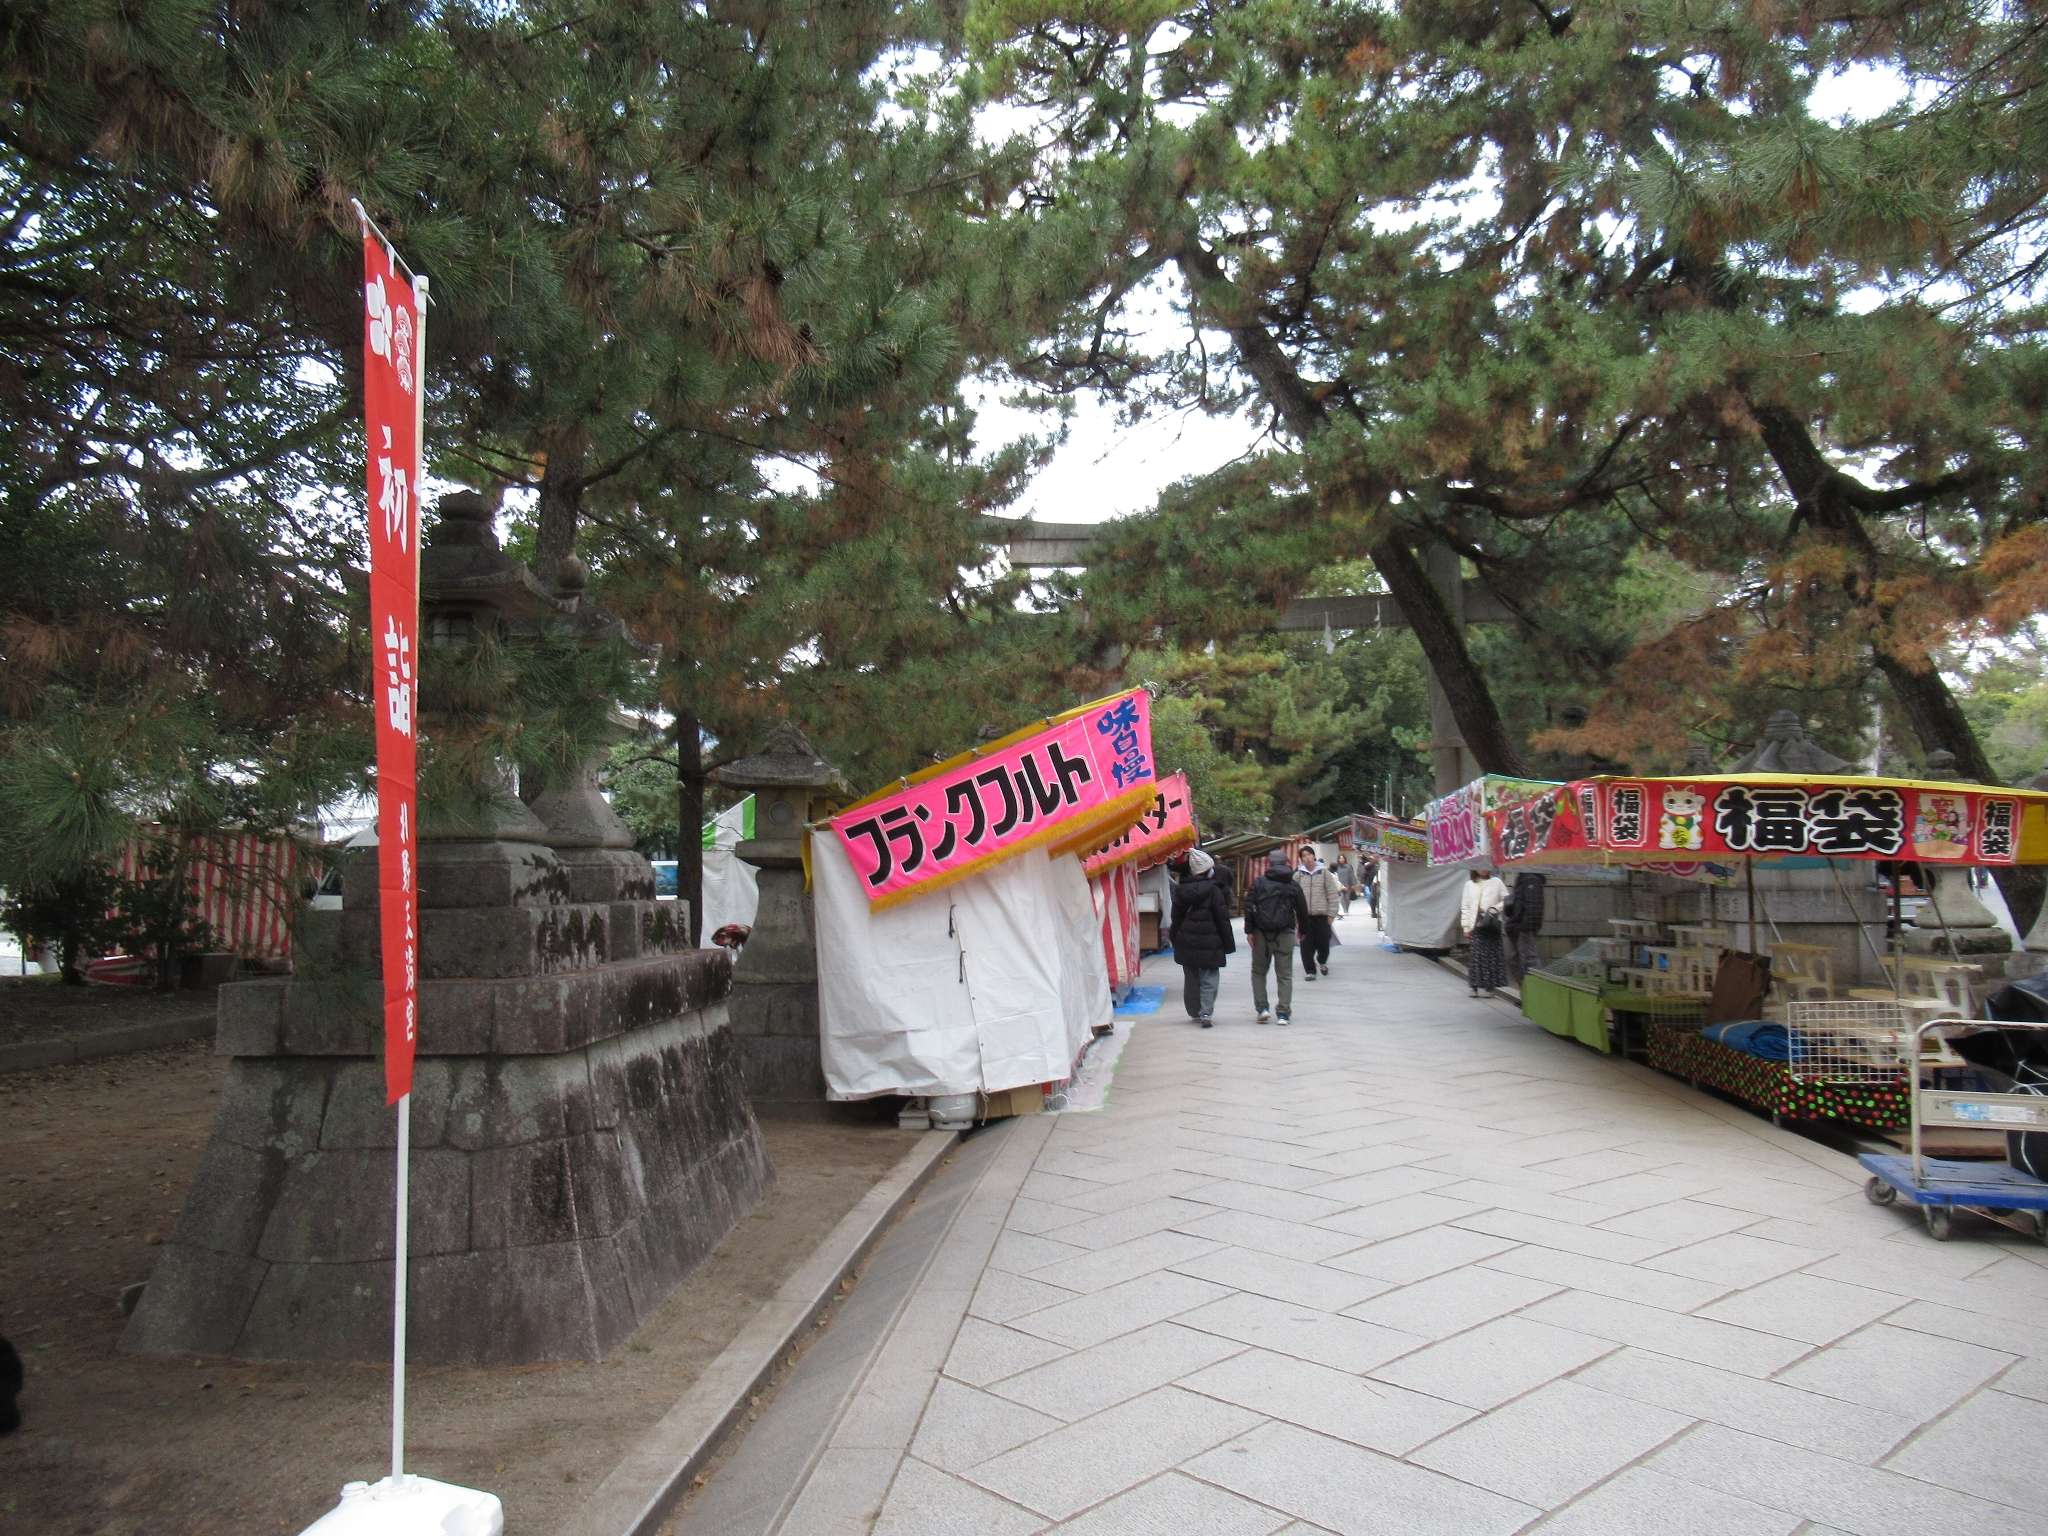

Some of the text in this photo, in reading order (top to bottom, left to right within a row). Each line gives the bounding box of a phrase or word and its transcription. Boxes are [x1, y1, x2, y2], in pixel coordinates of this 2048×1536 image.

[377, 425, 411, 740] 初詣
[1096, 698, 1152, 788] 味自慢
[844, 742, 1092, 887] フランクフルト
[1613, 787, 1641, 842] 福袋
[1713, 785, 1904, 855] 福袋
[1982, 799, 2013, 856] 福袋
